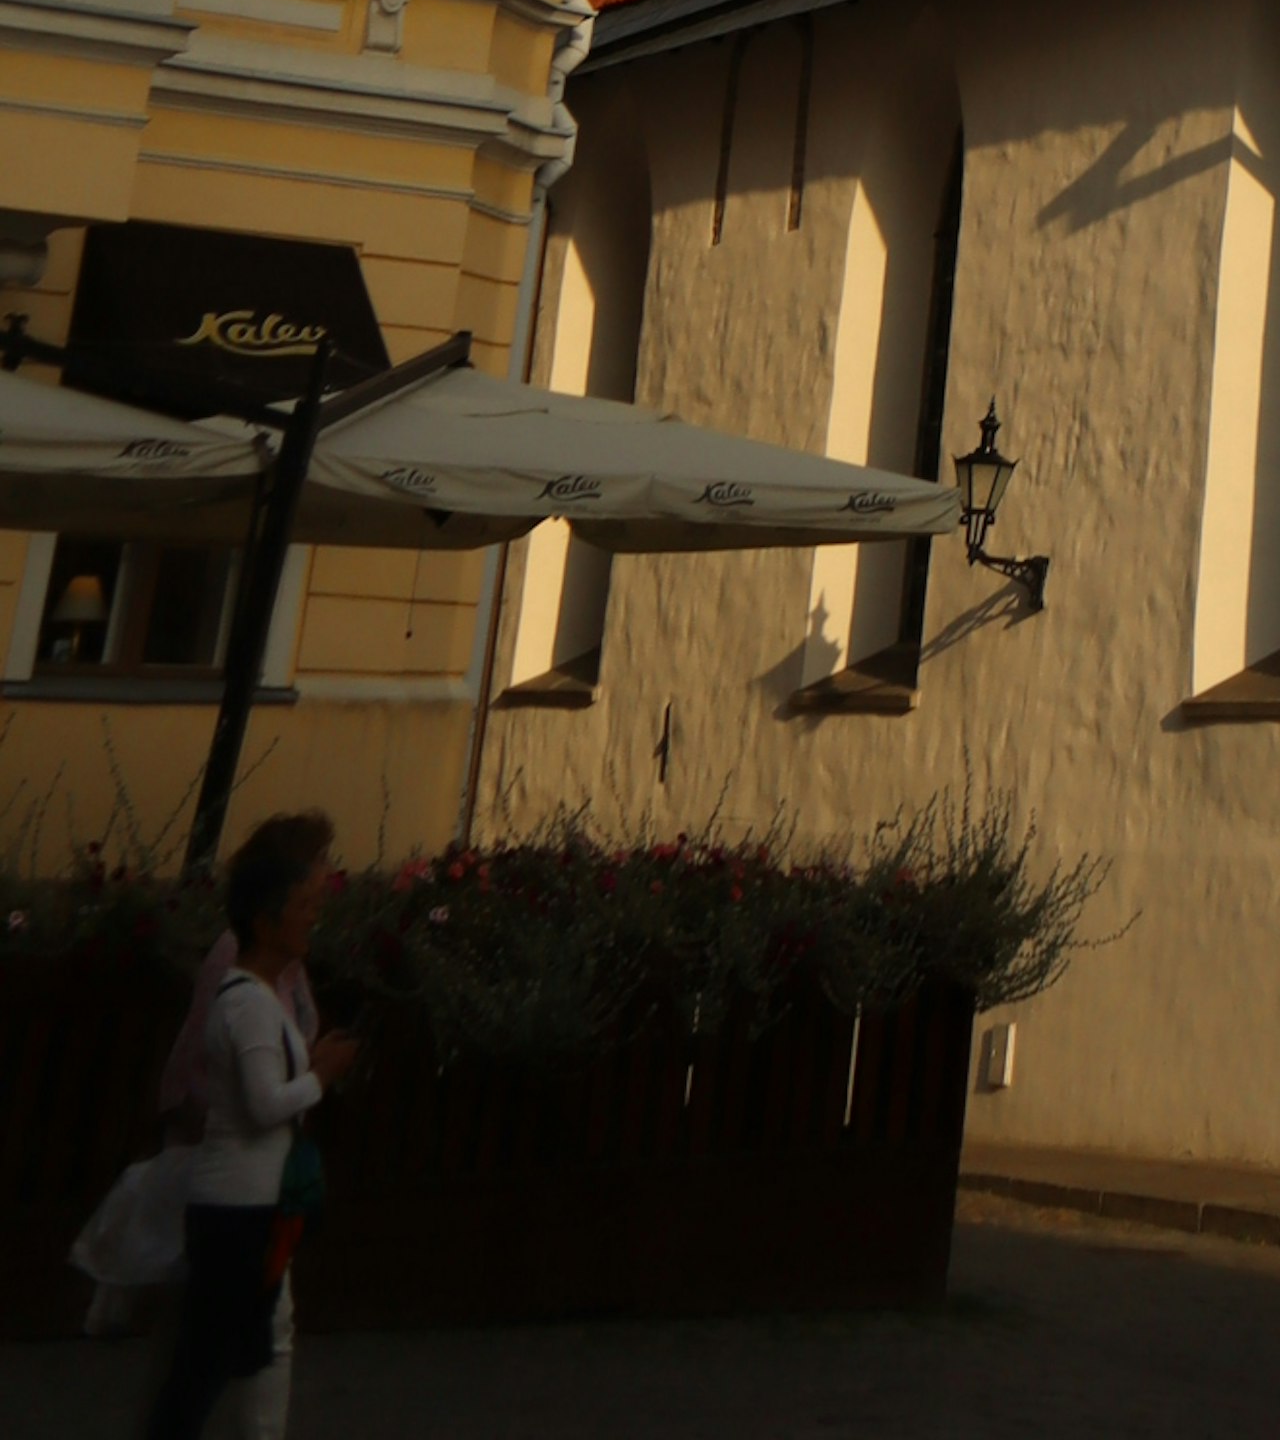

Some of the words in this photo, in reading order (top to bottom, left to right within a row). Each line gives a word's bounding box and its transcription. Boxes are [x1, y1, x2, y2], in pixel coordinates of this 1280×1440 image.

[176, 309, 327, 357] Kalev
[534, 474, 602, 502] Kalev
[691, 481, 755, 507] Kalev
